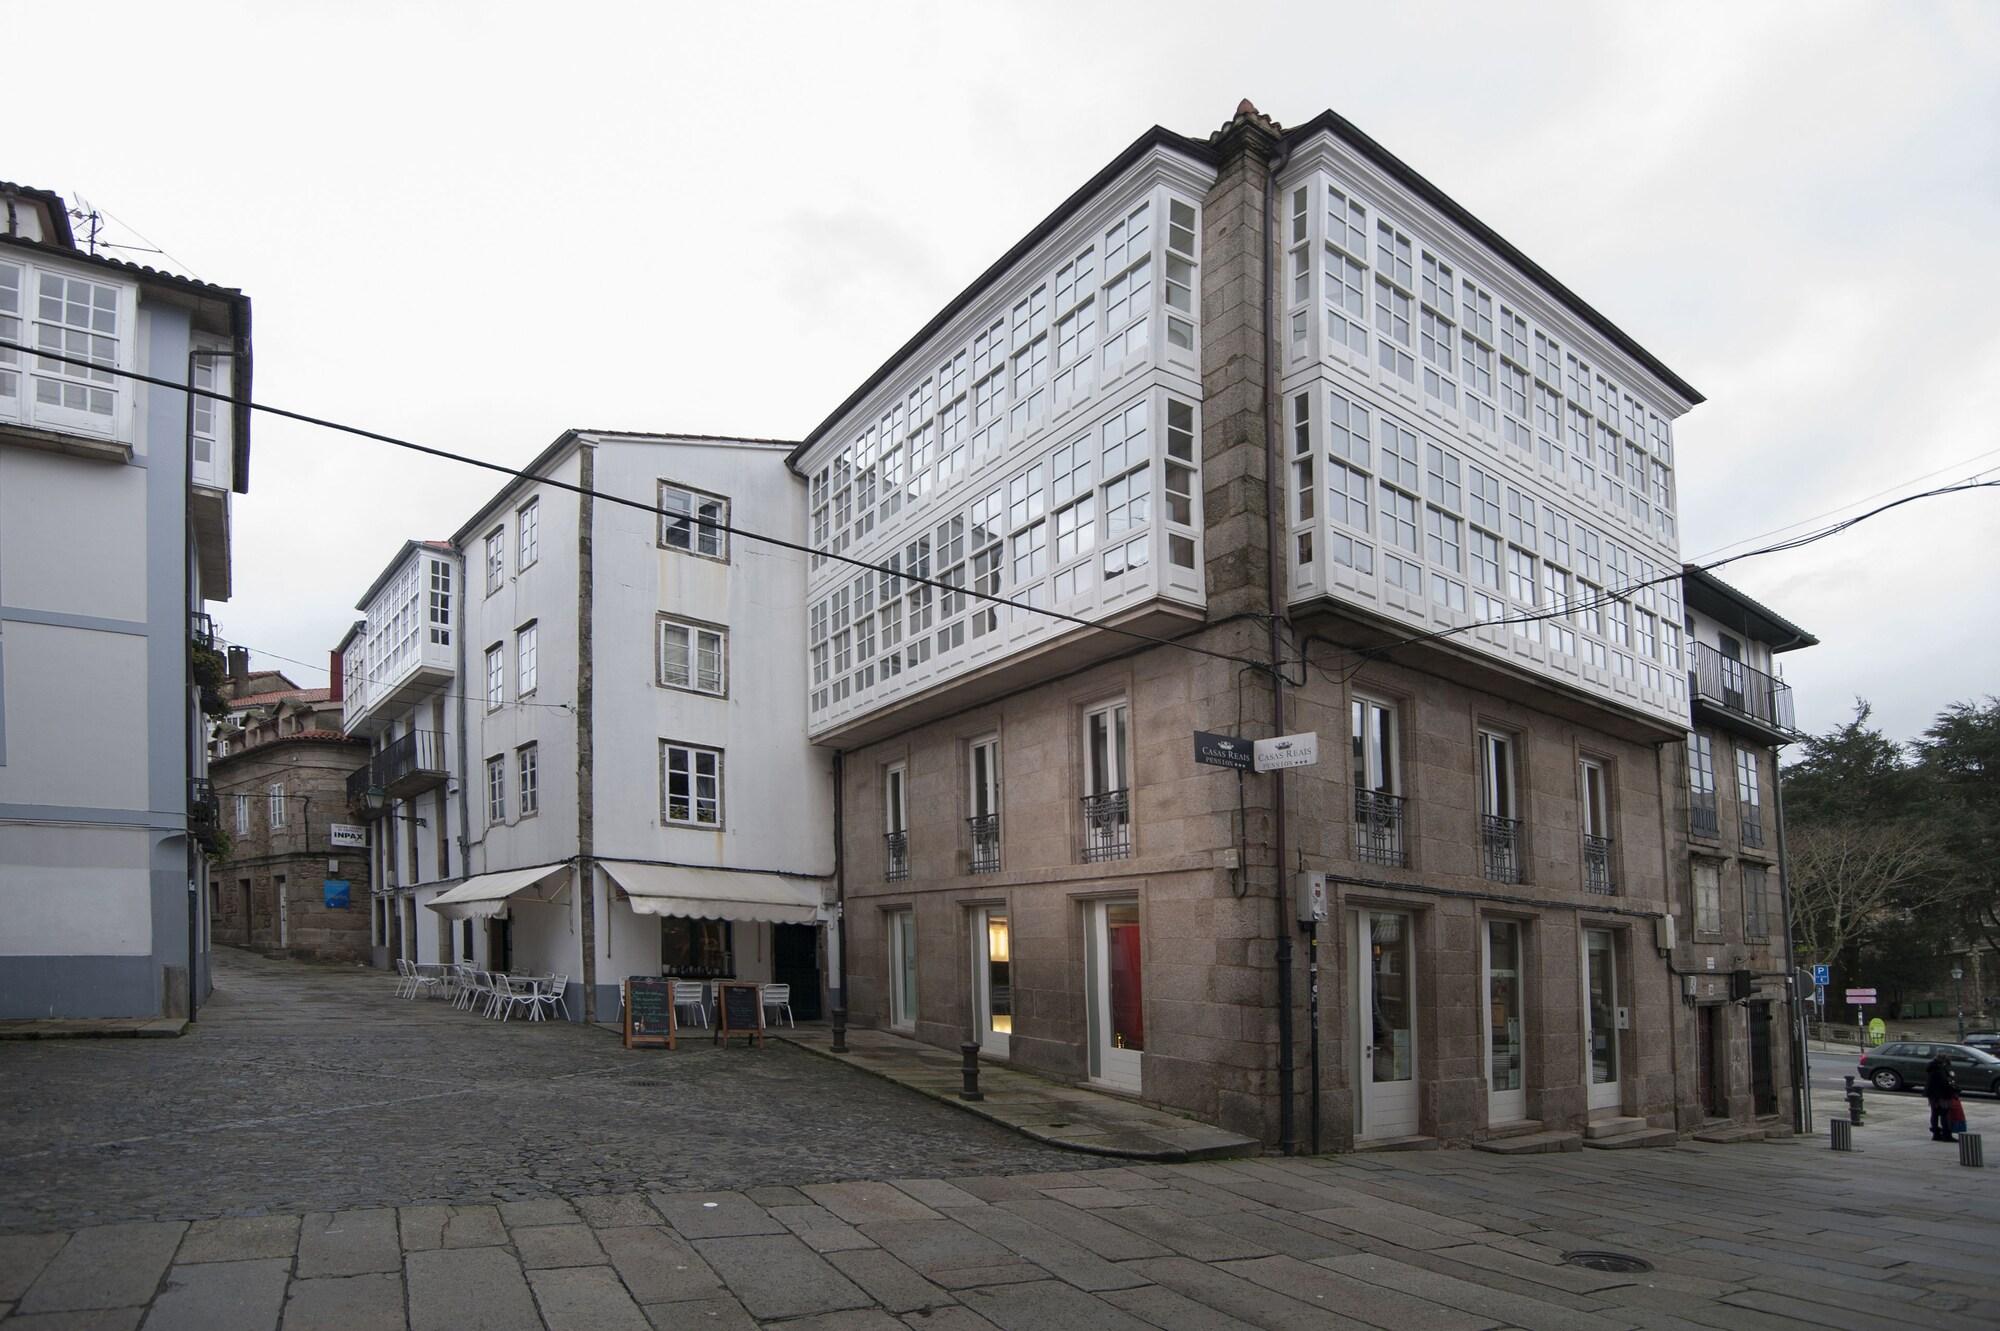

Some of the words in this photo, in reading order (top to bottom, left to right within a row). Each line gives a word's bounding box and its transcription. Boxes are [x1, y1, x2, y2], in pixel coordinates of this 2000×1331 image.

[1202, 746, 1226, 757] CASAS
[1228, 750, 1250, 761] REAIS
[1258, 751, 1283, 762] CASAS
[1286, 747, 1312, 758] REAIS
[334, 831, 363, 840] INPAX
